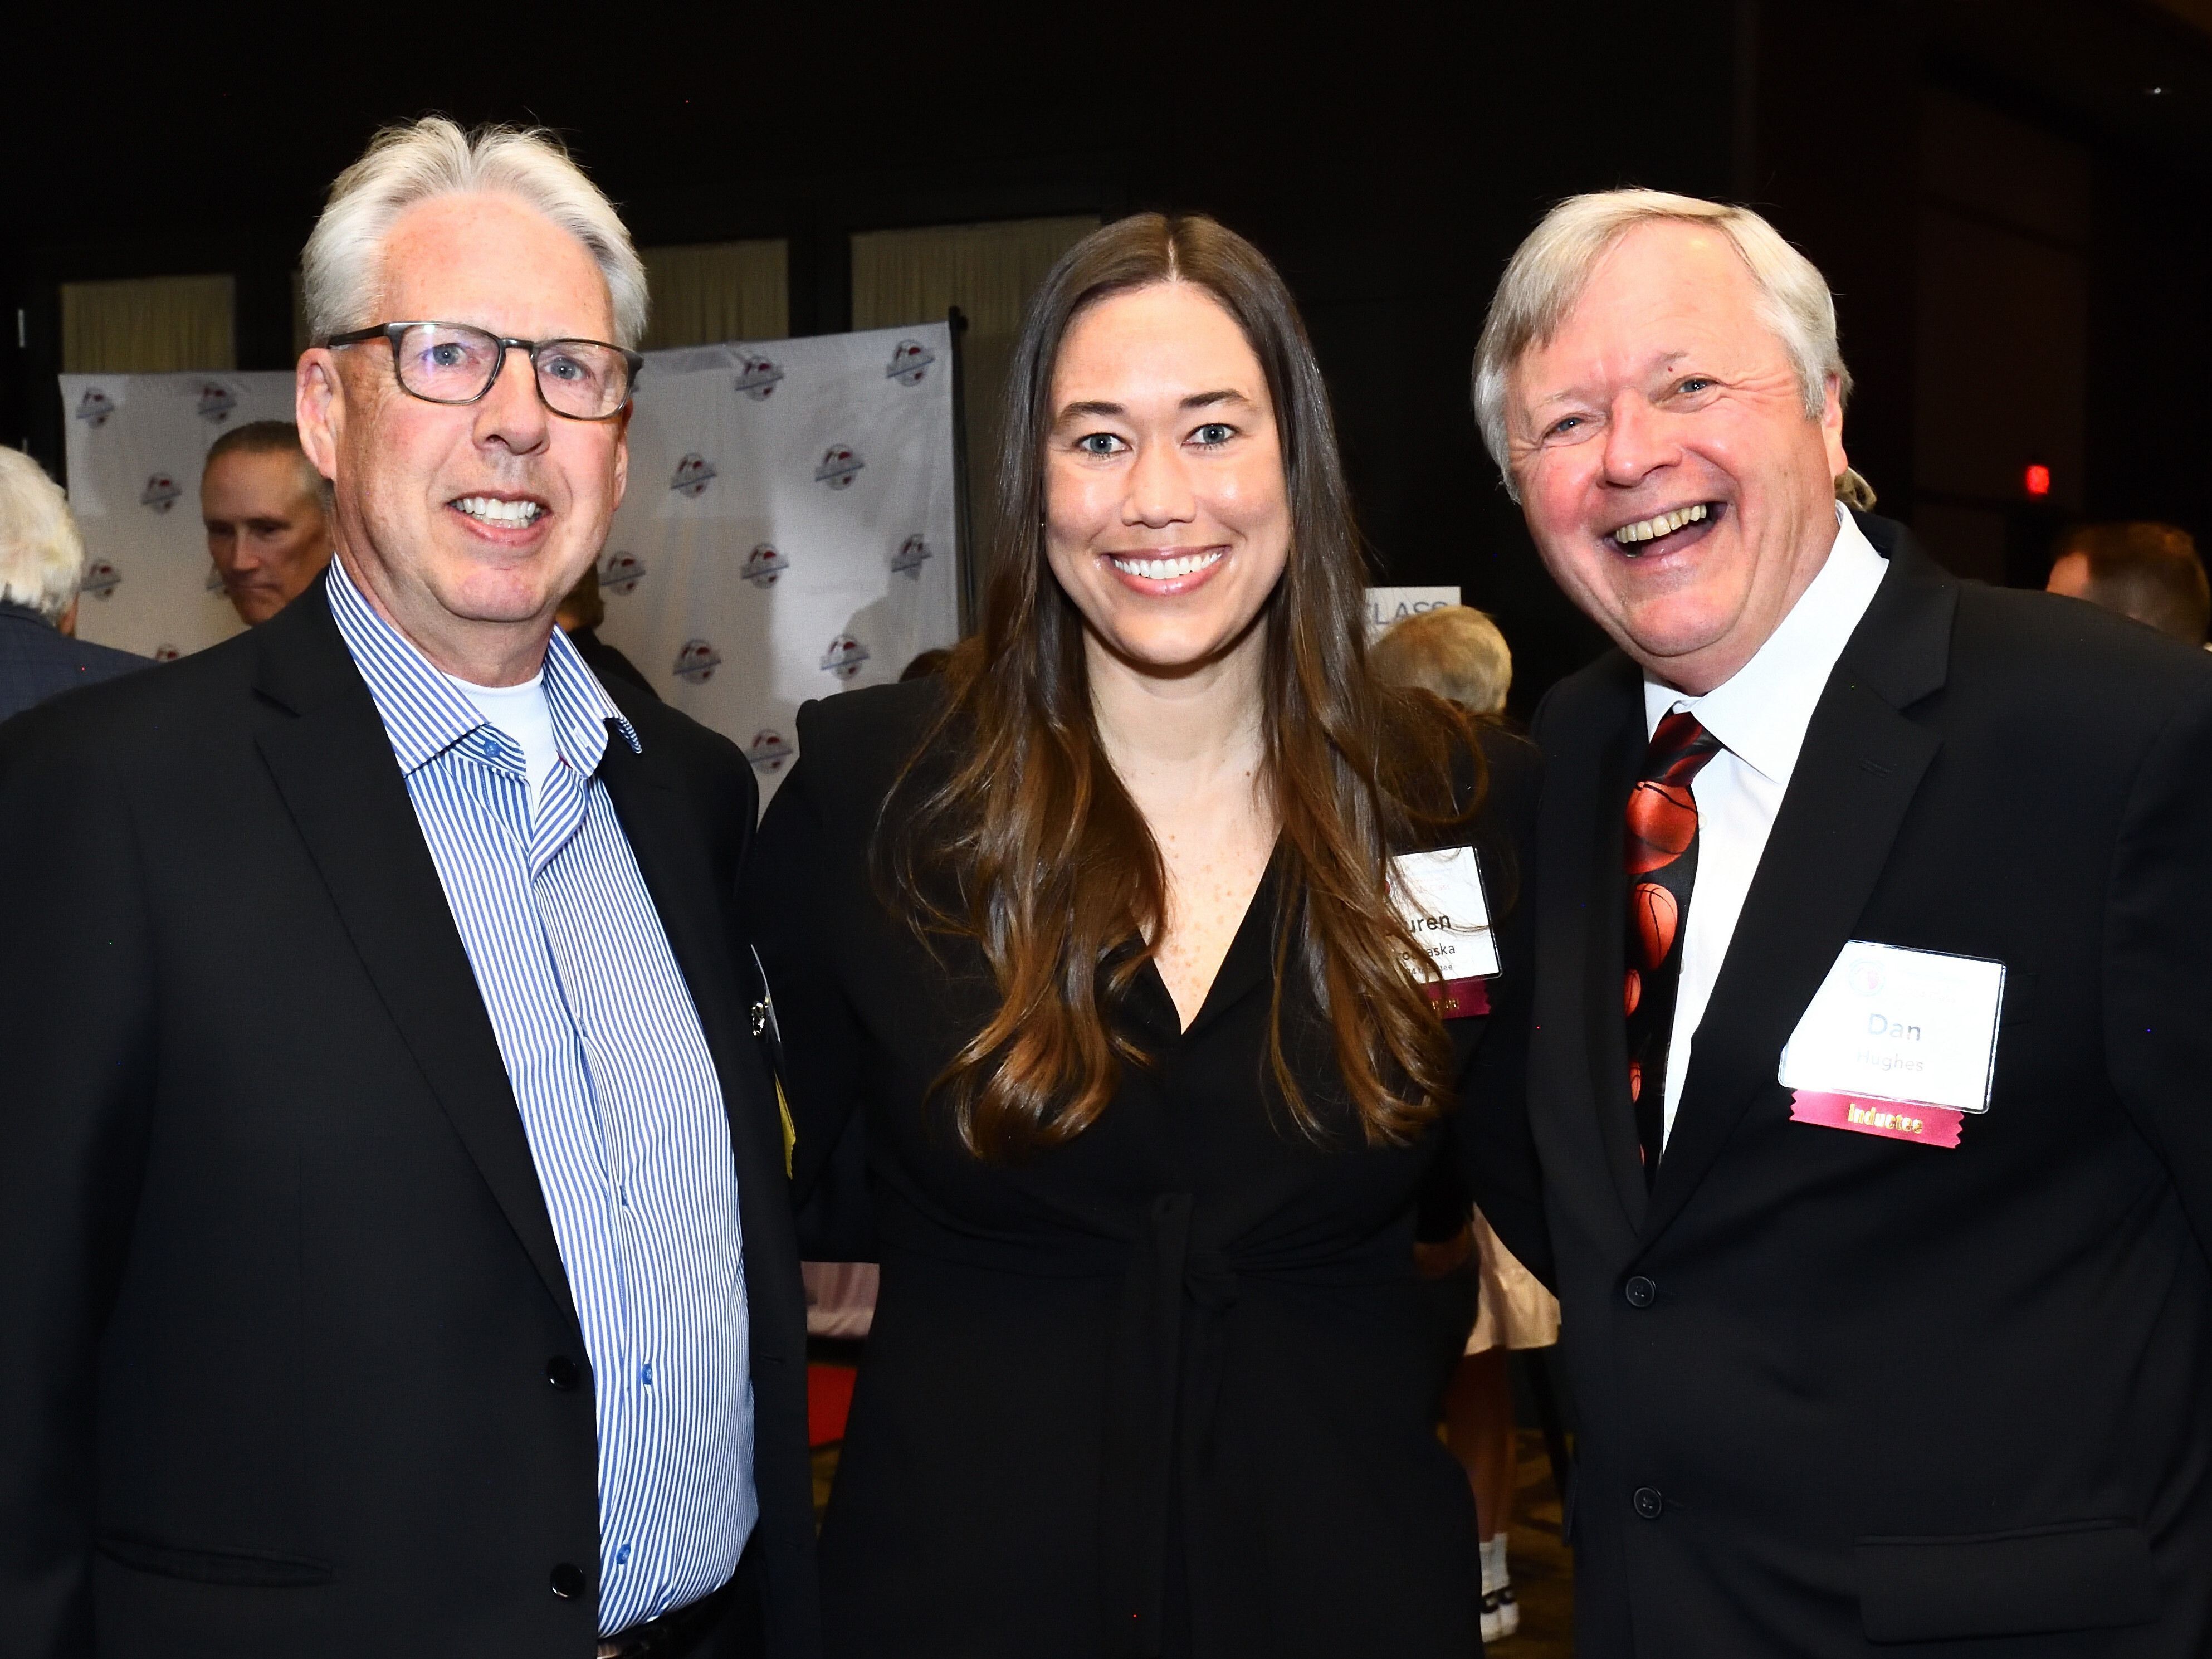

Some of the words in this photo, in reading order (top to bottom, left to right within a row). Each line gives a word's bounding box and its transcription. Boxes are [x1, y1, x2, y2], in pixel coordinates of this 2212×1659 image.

[1868, 1013, 1921, 1041] Dan
[1857, 1050, 1923, 1072] Hughes
[1848, 1103, 1923, 1134] Inductee
